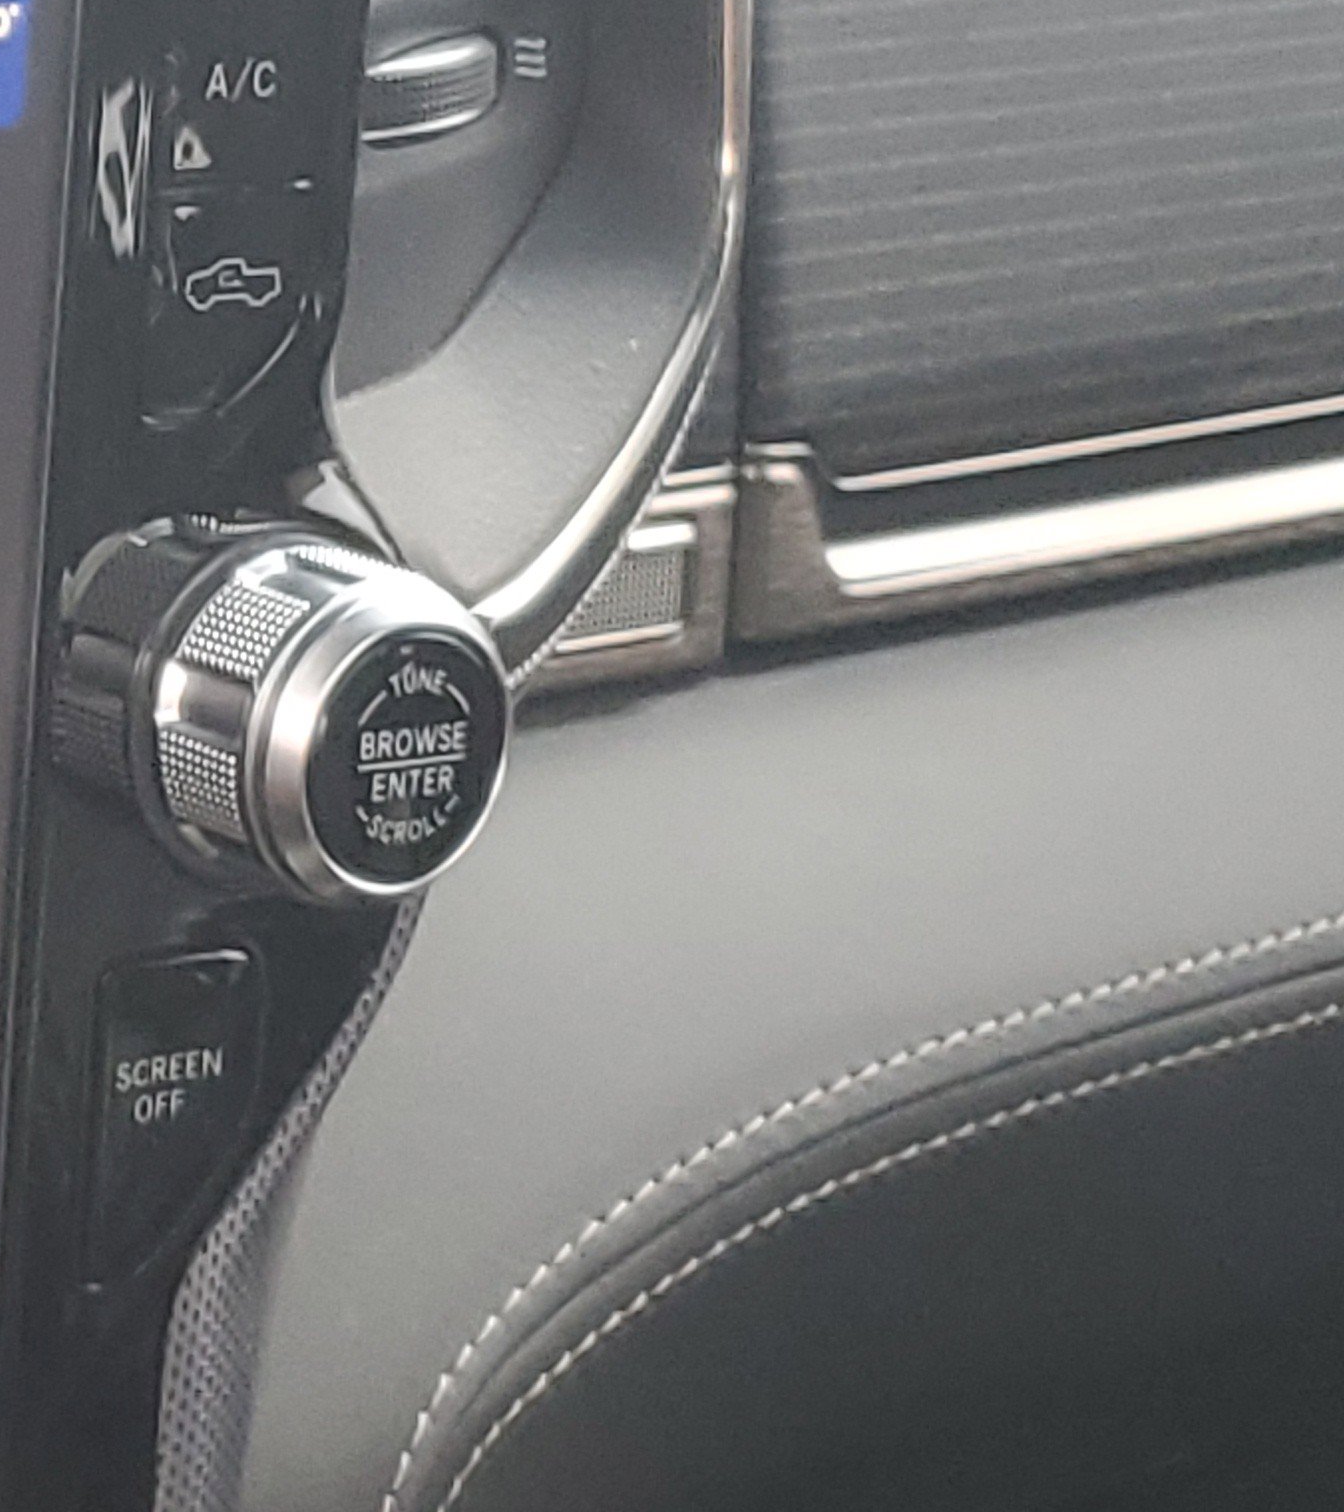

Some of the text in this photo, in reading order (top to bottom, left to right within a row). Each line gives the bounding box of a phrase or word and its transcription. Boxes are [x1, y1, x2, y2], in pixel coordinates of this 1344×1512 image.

[205, 61, 279, 99] A/C
[359, 721, 468, 762] BROWSE
[371, 767, 455, 803] ENTER
[366, 805, 448, 843] SCROLL
[115, 1048, 223, 1093] SCREEN
[133, 1090, 184, 1124] OFF
